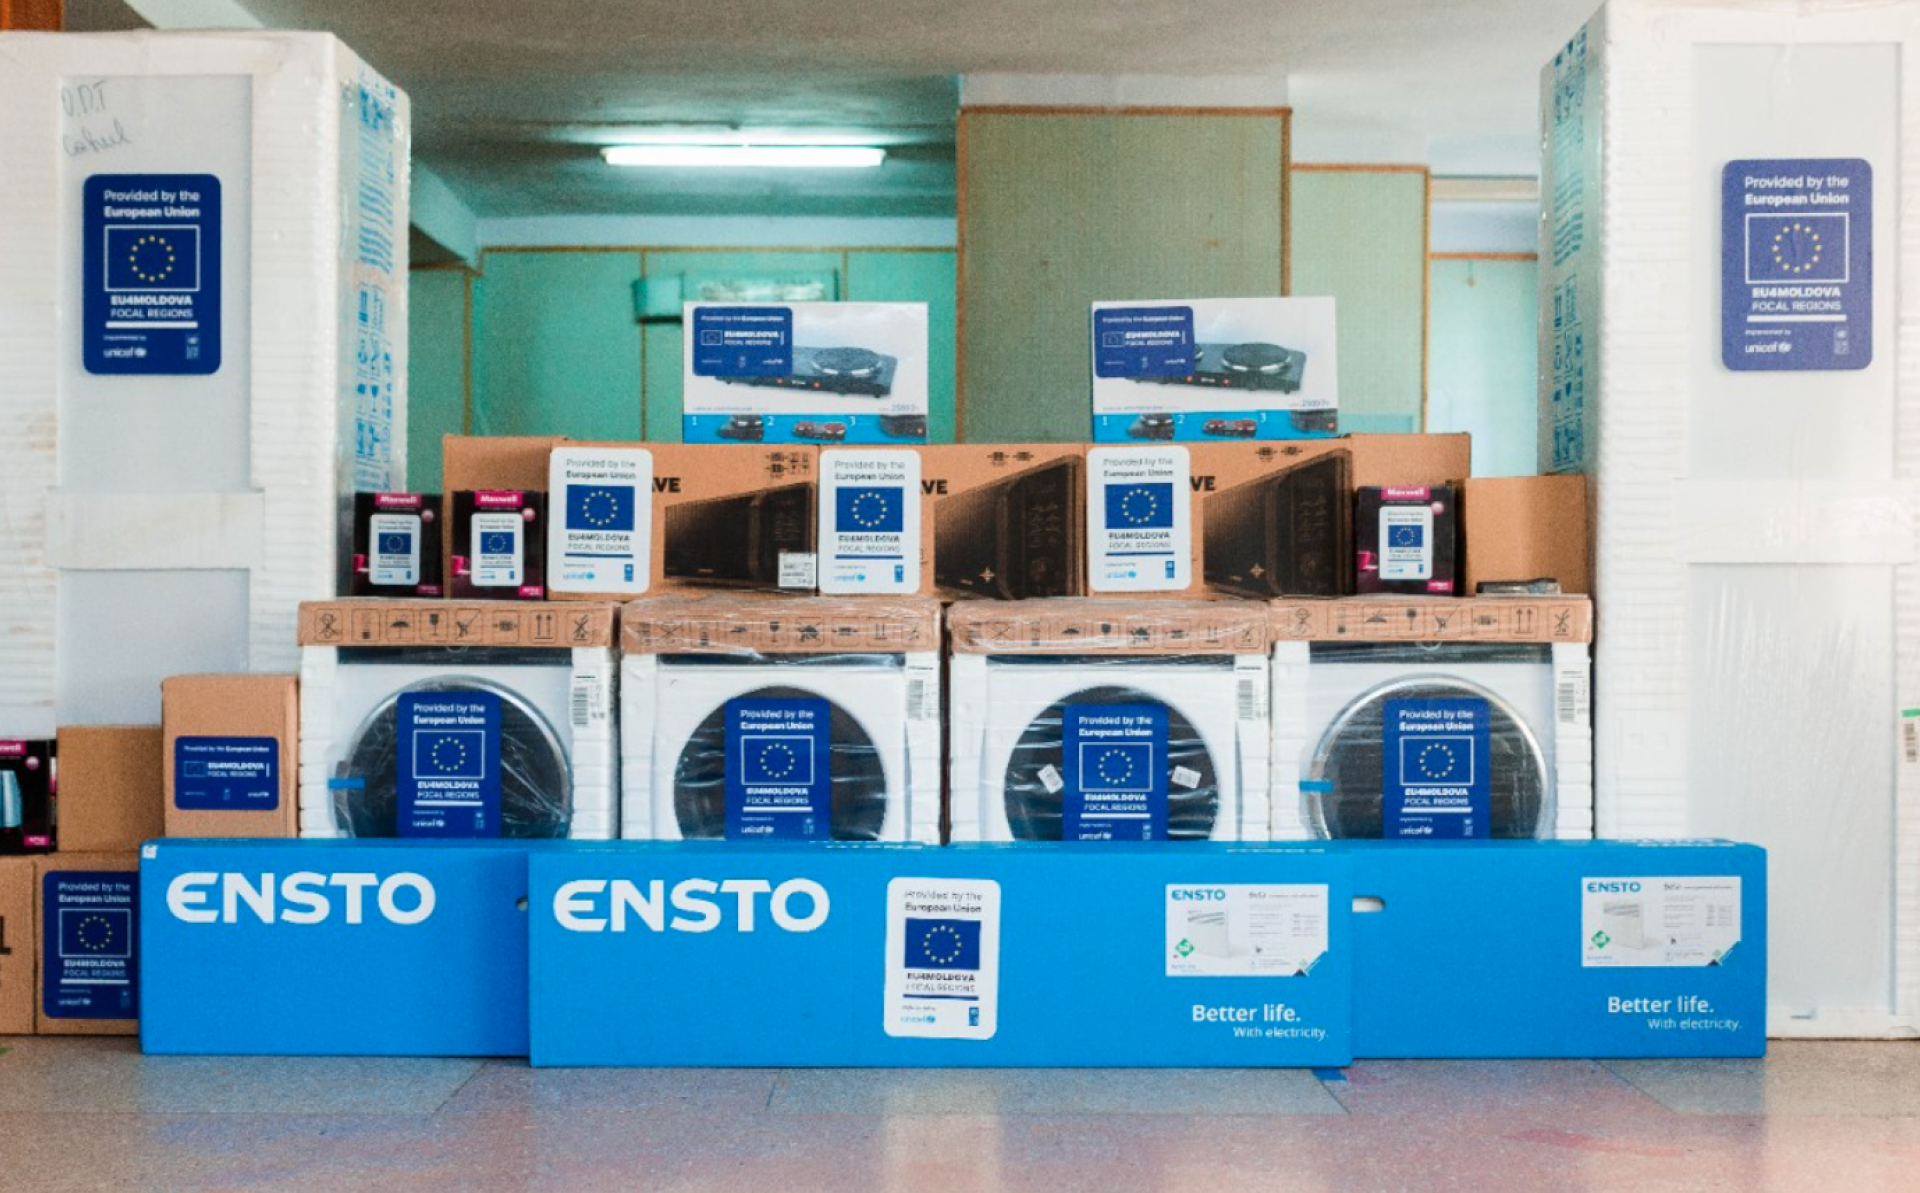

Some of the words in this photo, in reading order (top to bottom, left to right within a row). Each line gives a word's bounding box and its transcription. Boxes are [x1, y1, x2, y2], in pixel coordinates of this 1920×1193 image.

[1745, 176, 1803, 189] Provided
[1807, 175, 1822, 189] by
[1827, 175, 1848, 187] the
[104, 190, 158, 201] Provided
[161, 190, 175, 203] by
[180, 190, 200, 201] the
[1745, 193, 1807, 207] European
[1810, 192, 1849, 204] Union
[104, 206, 162, 219] European
[165, 206, 200, 217] Union
[1752, 287, 1841, 298] EU4MOLDOVA
[111, 295, 193, 305] EU4MOLDOVA
[1752, 302, 1789, 312] FOCAL
[1792, 301, 1841, 311] REGIONS
[110, 308, 144, 318] FOCAL
[148, 308, 193, 318] REGIONS
[1745, 342, 1778, 353] unicef
[692, 416, 697, 426] 1
[768, 416, 774, 426] 2
[851, 416, 856, 426] 3
[1102, 416, 1108, 426] 1
[1179, 414, 1185, 423] 2
[1261, 413, 1266, 422] 3
[566, 459, 605, 467] Provided
[608, 460, 618, 469] by
[835, 461, 875, 469] Provided
[877, 461, 887, 470] by
[890, 461, 905, 469] the
[1104, 458, 1142, 466] Provided
[1145, 458, 1156, 467] by
[1159, 457, 1173, 465] the
[567, 470, 608, 479] European
[835, 472, 876, 481] European
[879, 472, 905, 480] Union
[1104, 470, 1145, 478] European
[652, 477, 681, 493] VE
[413, 703, 454, 712] Provided
[457, 703, 467, 713] by
[470, 704, 485, 712] the
[413, 715, 457, 725] European
[458, 716, 486, 724] Union
[740, 710, 783, 718] Provided
[784, 710, 795, 720] by
[799, 710, 814, 718] the
[1399, 710, 1442, 718] Provided
[1443, 710, 1454, 720] by
[1457, 710, 1473, 718] the
[1079, 716, 1120, 724] Provided
[1122, 716, 1134, 726] by
[1136, 716, 1152, 724] the
[740, 722, 785, 732] European
[786, 722, 814, 730] Union
[1399, 722, 1444, 732] European
[1445, 722, 1474, 731] Union
[1079, 728, 1123, 738] European
[1125, 728, 1153, 736] Union
[417, 791, 443, 799] FOCAL
[58, 882, 100, 892] Provided
[102, 882, 112, 893] by
[115, 883, 130, 892] the
[1587, 881, 1641, 893] ENSTO
[58, 894, 103, 904] European
[104, 895, 131, 903] Union
[166, 871, 436, 924] ENSTO
[905, 890, 947, 900] Provided
[952, 891, 963, 902] by
[966, 892, 982, 901] the
[1171, 889, 1226, 900] ENSTO
[553, 878, 830, 932] ENSTO
[905, 902, 951, 912] European
[953, 904, 982, 913] Union
[908, 972, 975, 981] EU4MOLDOVA
[1607, 996, 1672, 1013] Better
[1677, 995, 1714, 1013] life.
[1192, 1004, 1258, 1022] Better
[1263, 1004, 1301, 1022] life.
[1647, 1019, 1676, 1030] With
[1679, 1019, 1742, 1031] electricity.
[1233, 1027, 1263, 1037] With
[1265, 1027, 1328, 1041] electricity.
